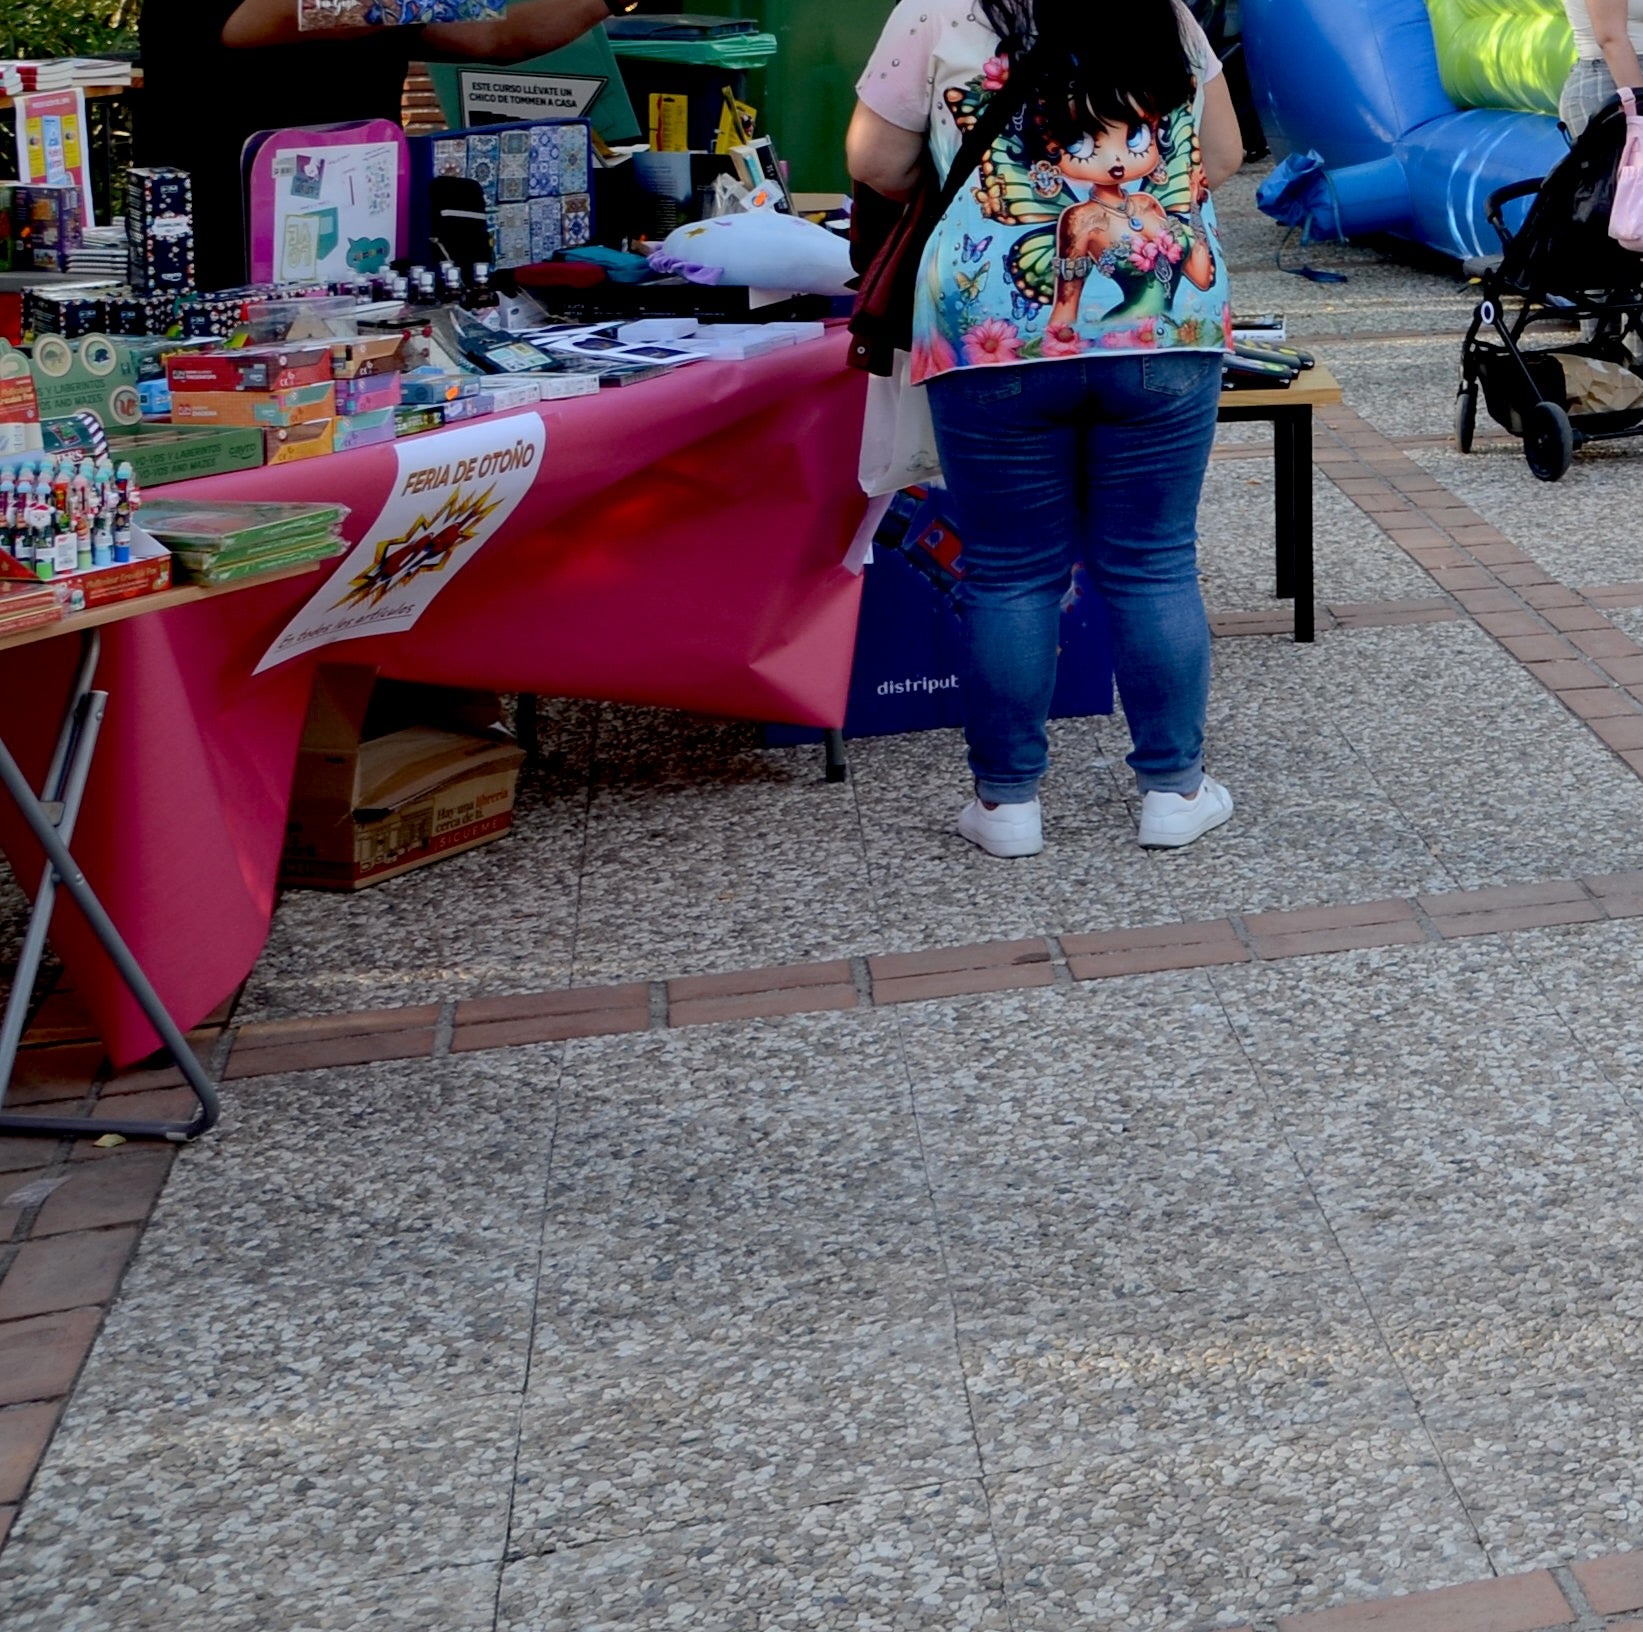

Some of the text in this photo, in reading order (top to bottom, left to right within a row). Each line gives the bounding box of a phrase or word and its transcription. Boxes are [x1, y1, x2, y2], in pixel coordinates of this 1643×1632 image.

[472, 82, 573, 97] ESTE CURSO LLÉVATE UN
[469, 92, 577, 108] CHICO DE TOMMEN A CASA
[402, 439, 535, 497] FERIA DE OTOÑO
